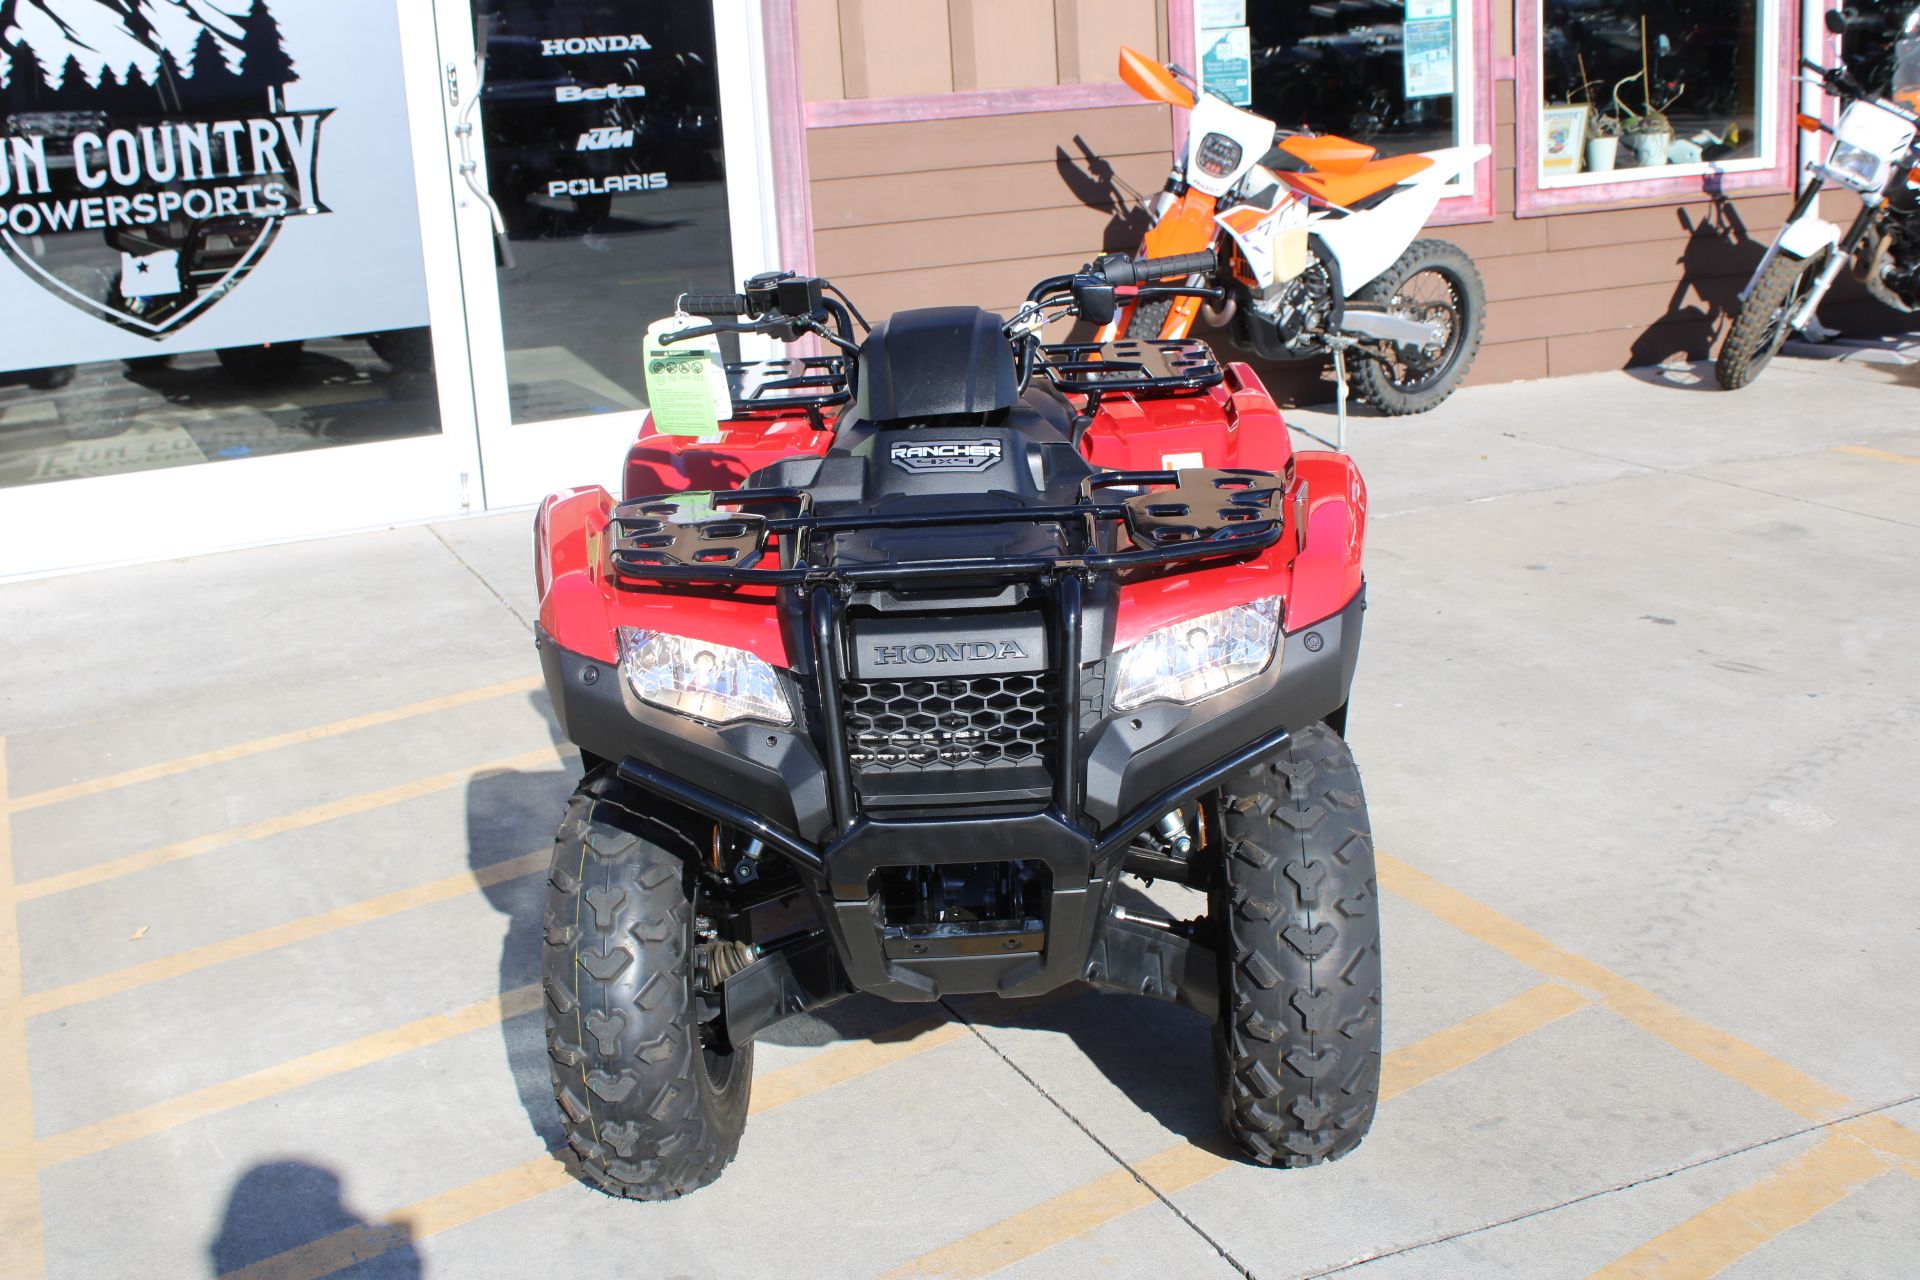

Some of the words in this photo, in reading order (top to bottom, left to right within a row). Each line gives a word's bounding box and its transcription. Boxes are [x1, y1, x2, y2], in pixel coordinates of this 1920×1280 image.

[541, 34, 652, 56] HONDA
[555, 83, 646, 102] Beta
[576, 126, 634, 151] KTM
[72, 114, 320, 209] COUNTRY
[548, 172, 668, 198] POLARIS
[891, 445, 1001, 459] RANCHER
[874, 640, 1028, 665] HONDA
